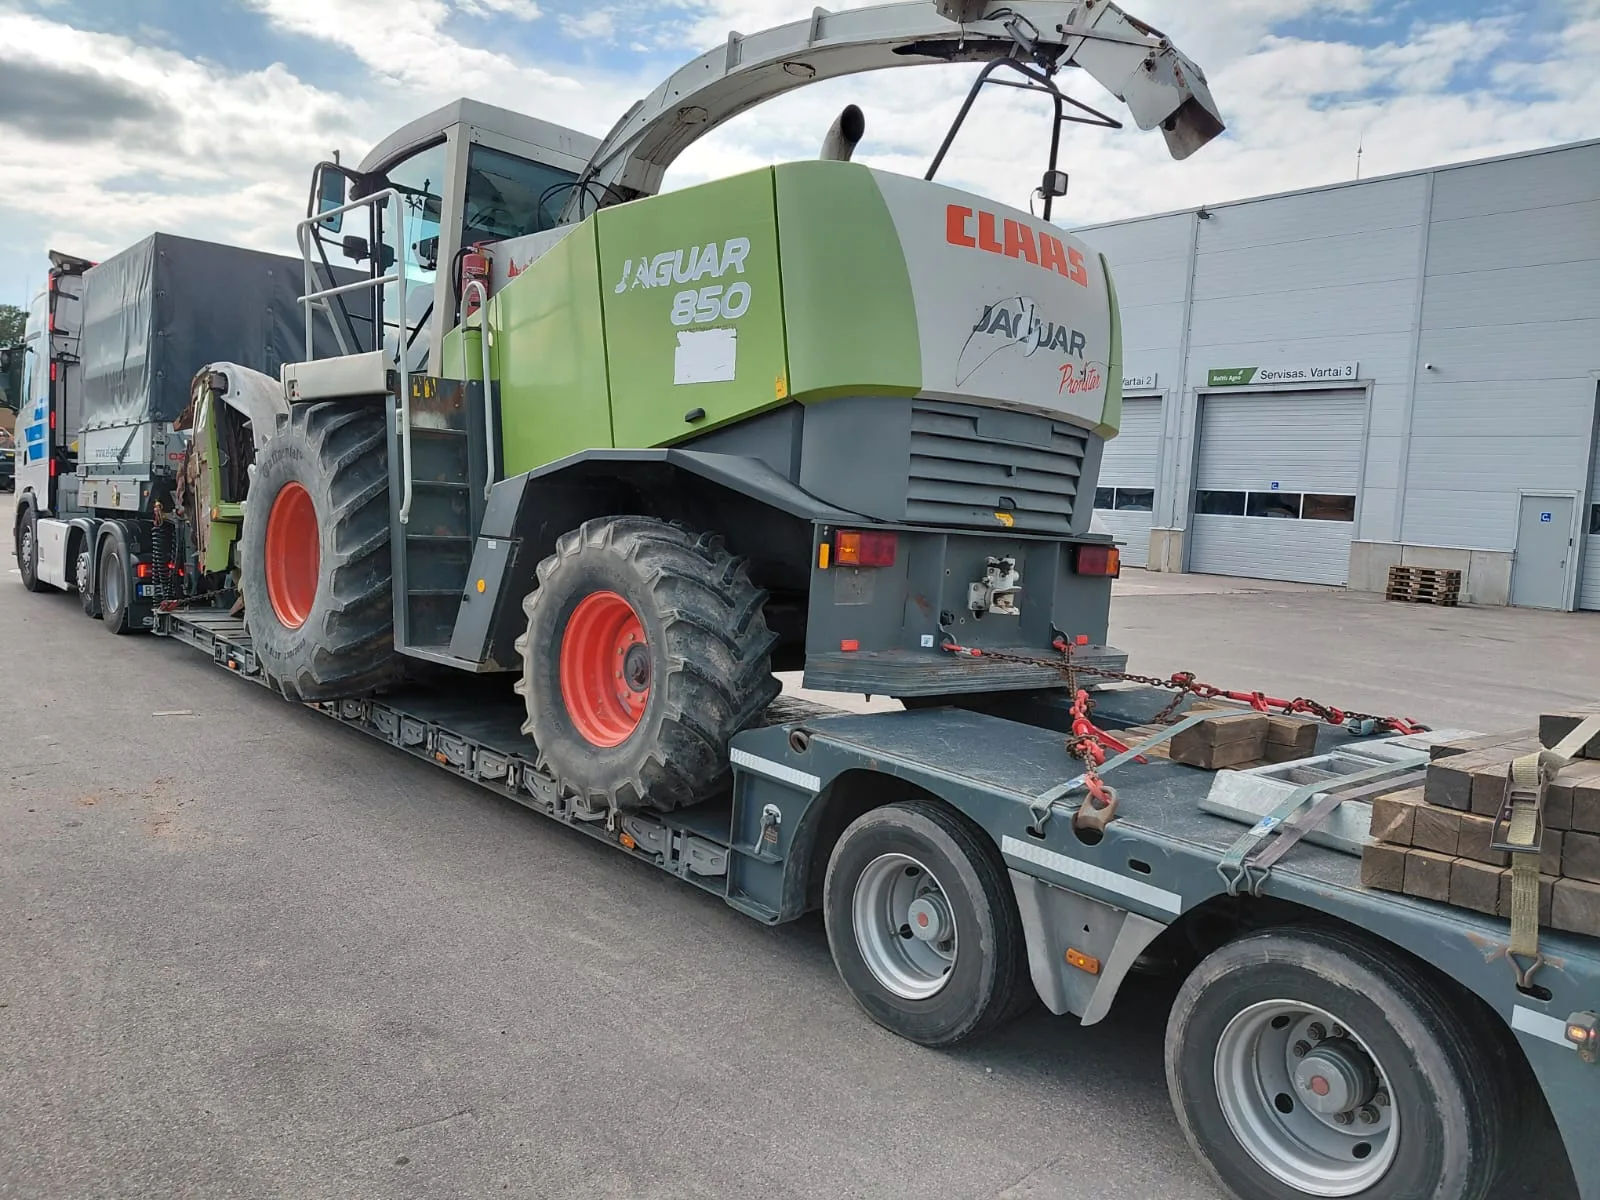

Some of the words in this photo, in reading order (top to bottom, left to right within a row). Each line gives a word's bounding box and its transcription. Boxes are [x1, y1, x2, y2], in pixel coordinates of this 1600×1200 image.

[614, 237, 750, 293] JAGUAR
[946, 204, 1088, 288] CLAAS
[670, 281, 752, 325] 850
[1146, 376, 1152, 385] 2
[1310, 367, 1342, 377] Vartai
[1345, 366, 1352, 376] 3
